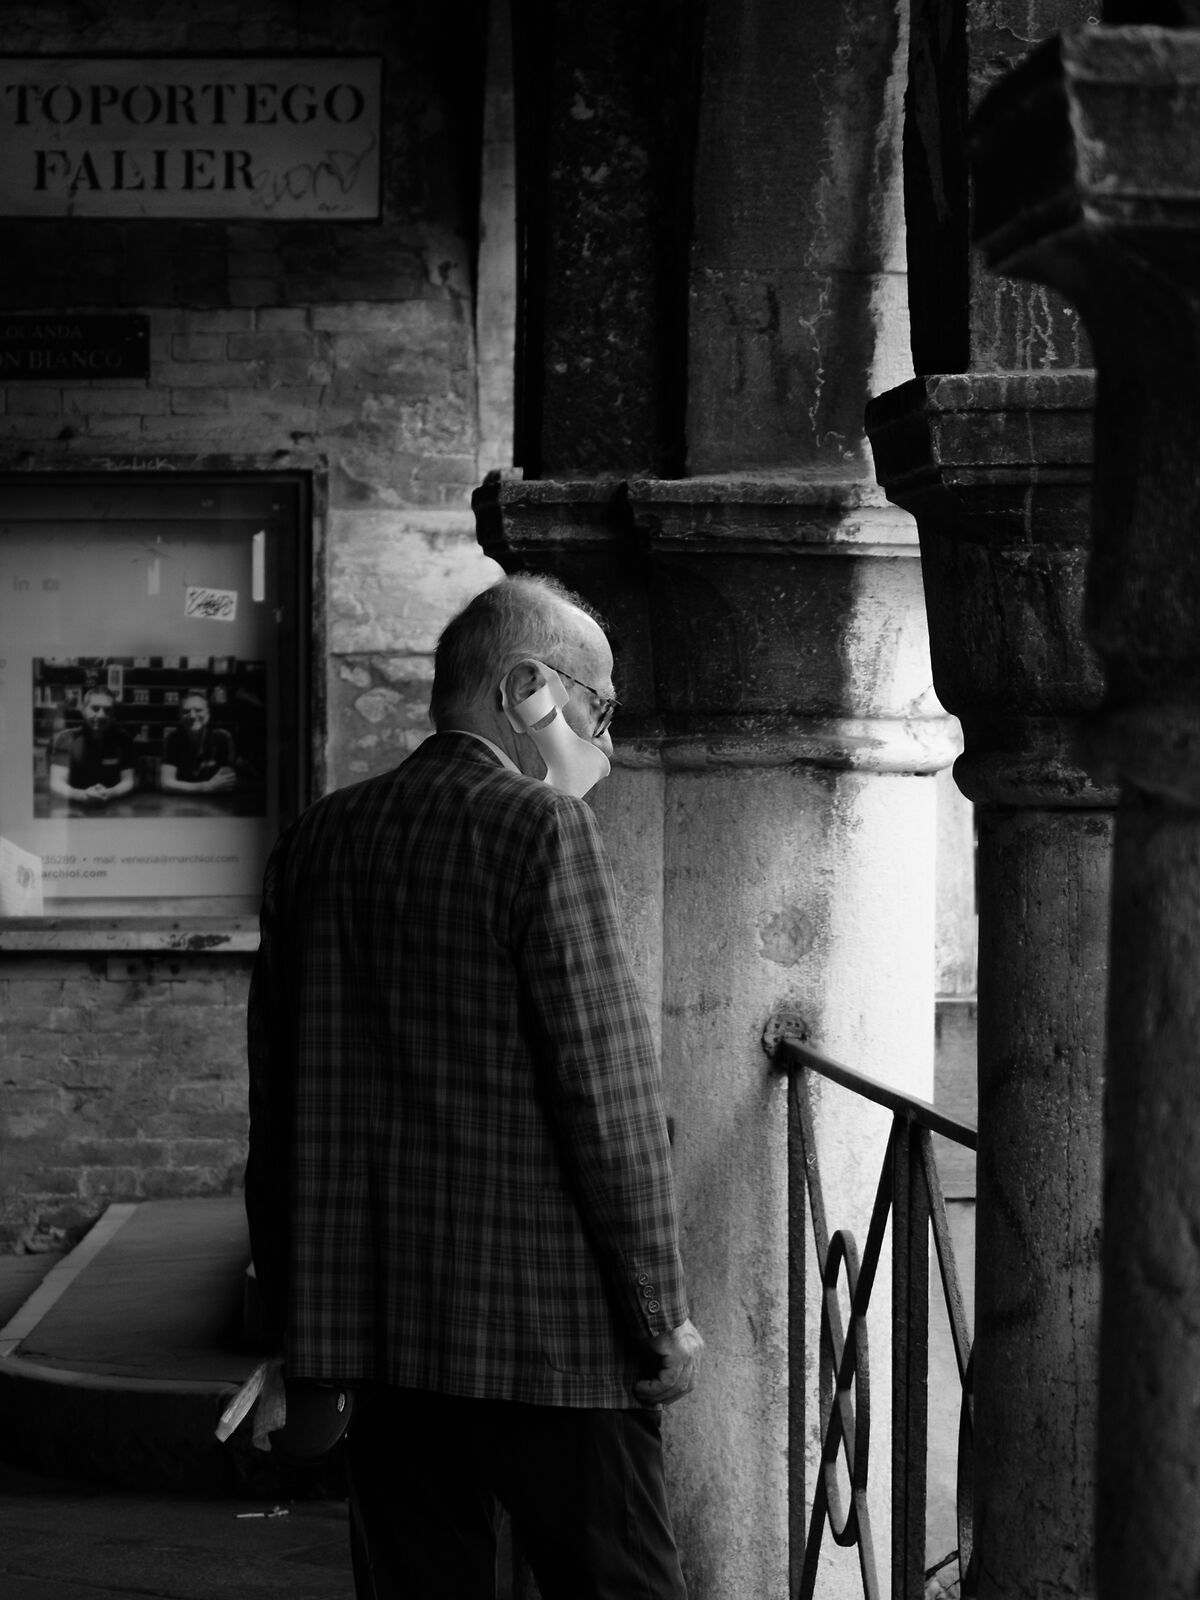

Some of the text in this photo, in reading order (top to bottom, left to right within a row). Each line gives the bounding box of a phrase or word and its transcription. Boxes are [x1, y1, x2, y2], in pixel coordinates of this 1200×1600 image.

[33, 149, 256, 190] FALIER
[30, 349, 123, 369] BIANCO
[41, 869, 108, 879] archiol.com
